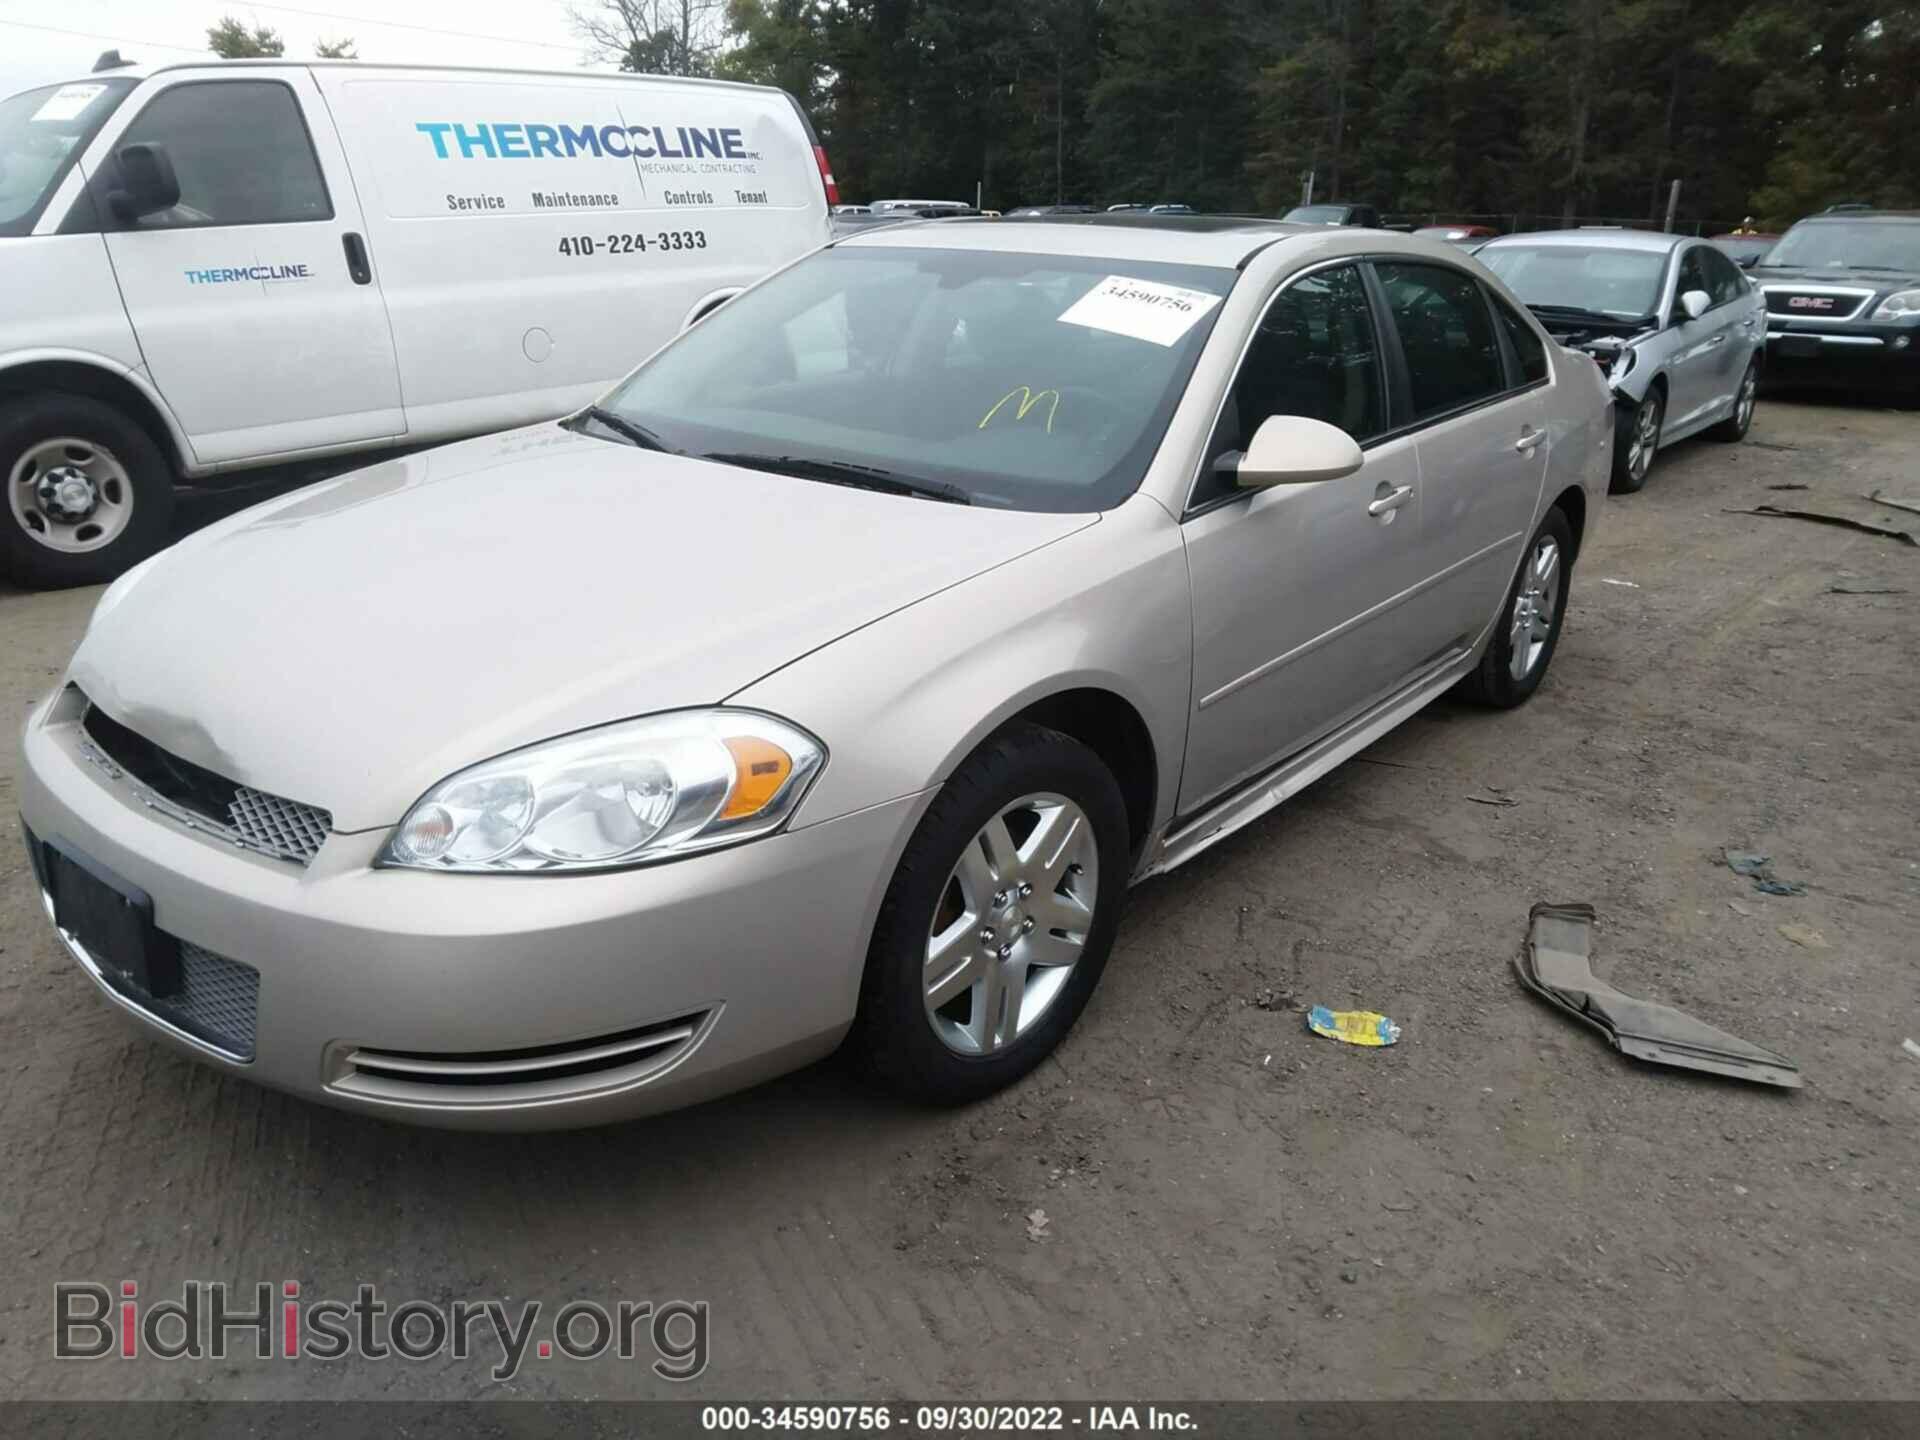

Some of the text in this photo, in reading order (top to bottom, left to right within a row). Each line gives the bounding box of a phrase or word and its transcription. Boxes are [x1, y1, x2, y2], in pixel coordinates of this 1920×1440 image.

[640, 163, 758, 174] MECHANICAL CONTRACTING
[446, 190, 768, 211] Service Maintenance Controls Tenant
[558, 230, 708, 256] 410-224-3333
[1101, 285, 1193, 313] 34590756
[1788, 296, 1834, 309] GMC
